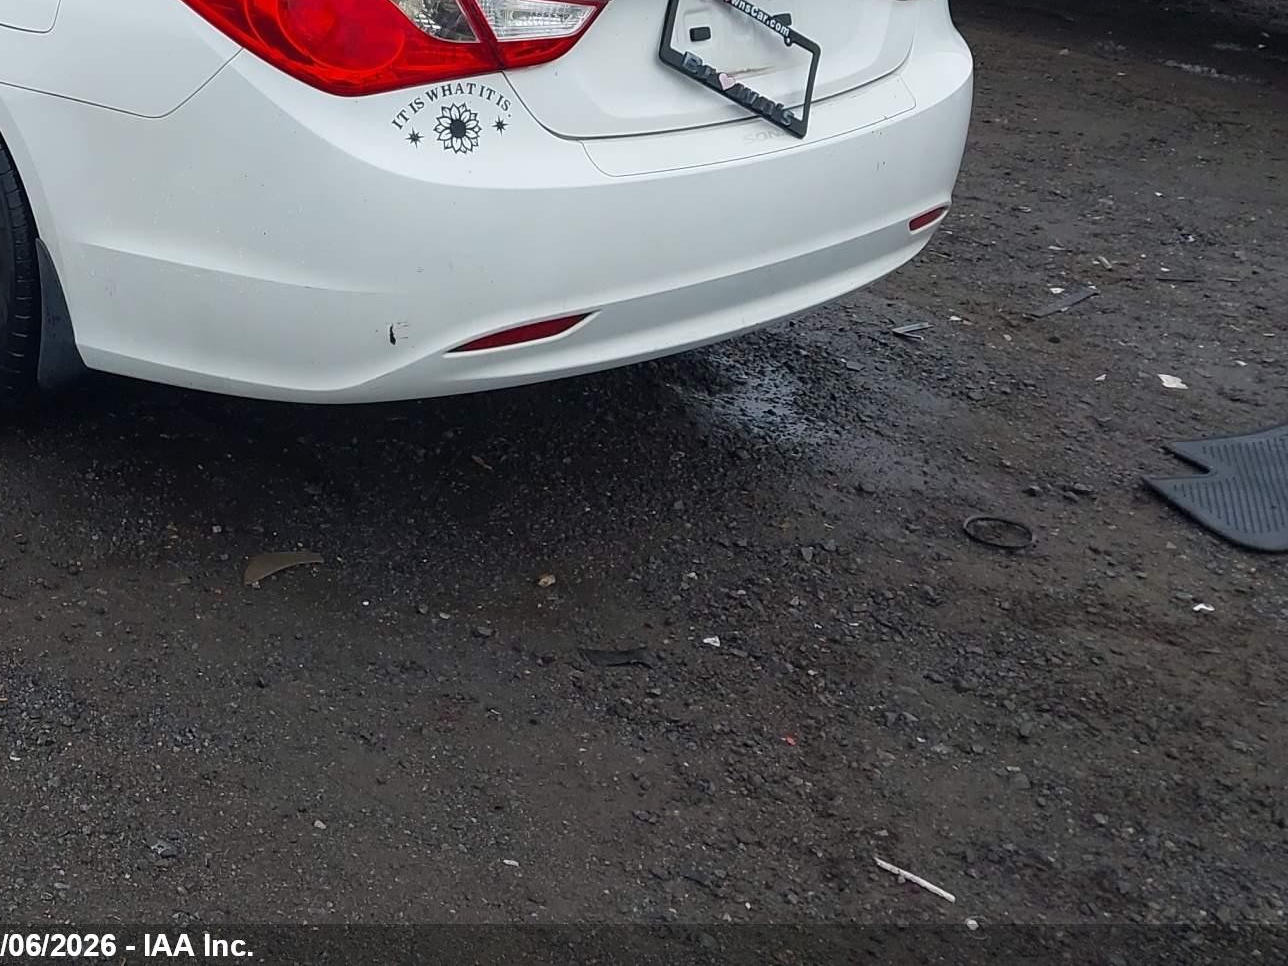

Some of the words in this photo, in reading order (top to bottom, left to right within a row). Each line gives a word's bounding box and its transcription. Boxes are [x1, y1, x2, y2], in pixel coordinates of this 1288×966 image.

[392, 109, 410, 130] IT
[408, 97, 425, 114] IS
[425, 82, 477, 102] WHAT
[479, 85, 496, 101] IT
